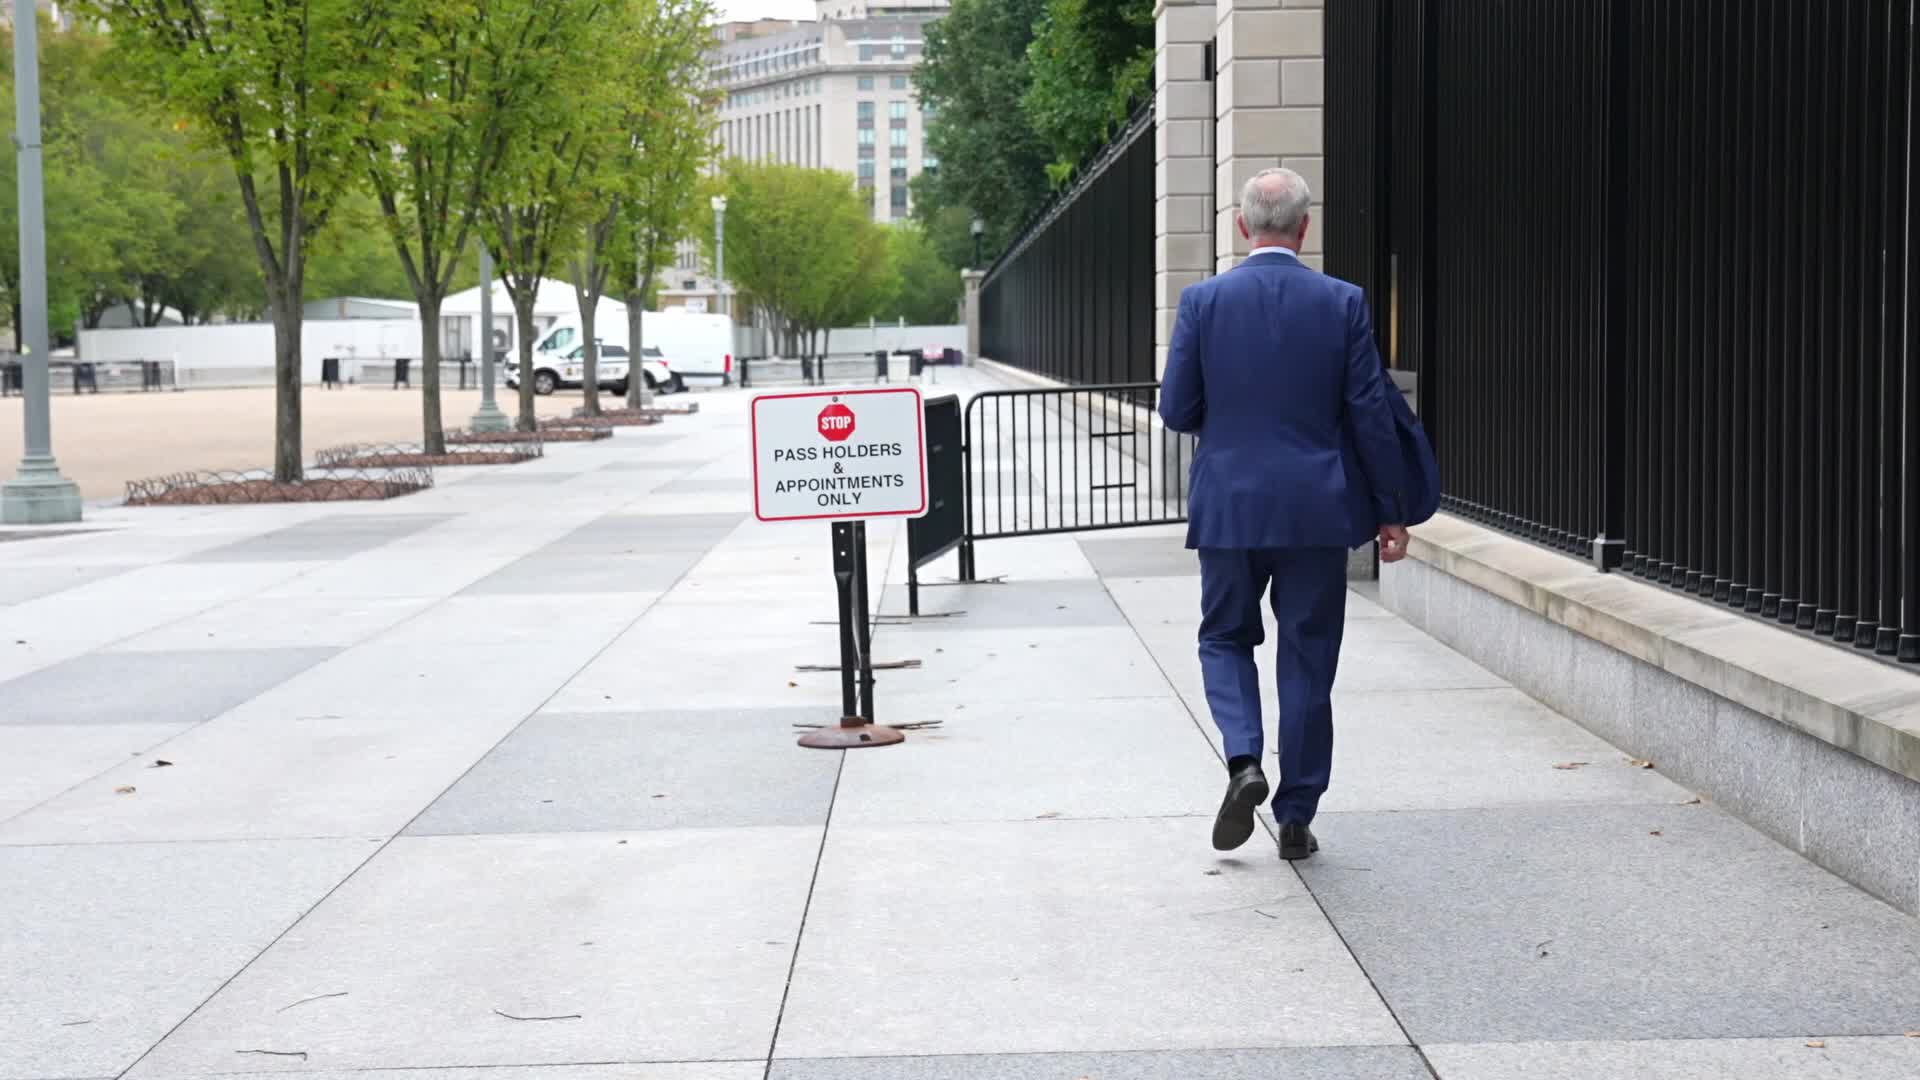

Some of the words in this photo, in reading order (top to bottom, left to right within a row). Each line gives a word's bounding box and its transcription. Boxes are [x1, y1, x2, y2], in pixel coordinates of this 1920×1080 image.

[821, 416, 851, 430] STOP
[774, 447, 817, 462] PASS
[823, 443, 902, 459] HOLDERS
[833, 462, 844, 475] &
[775, 474, 904, 493] APPOINTMENTS
[817, 492, 862, 507] ONLY
